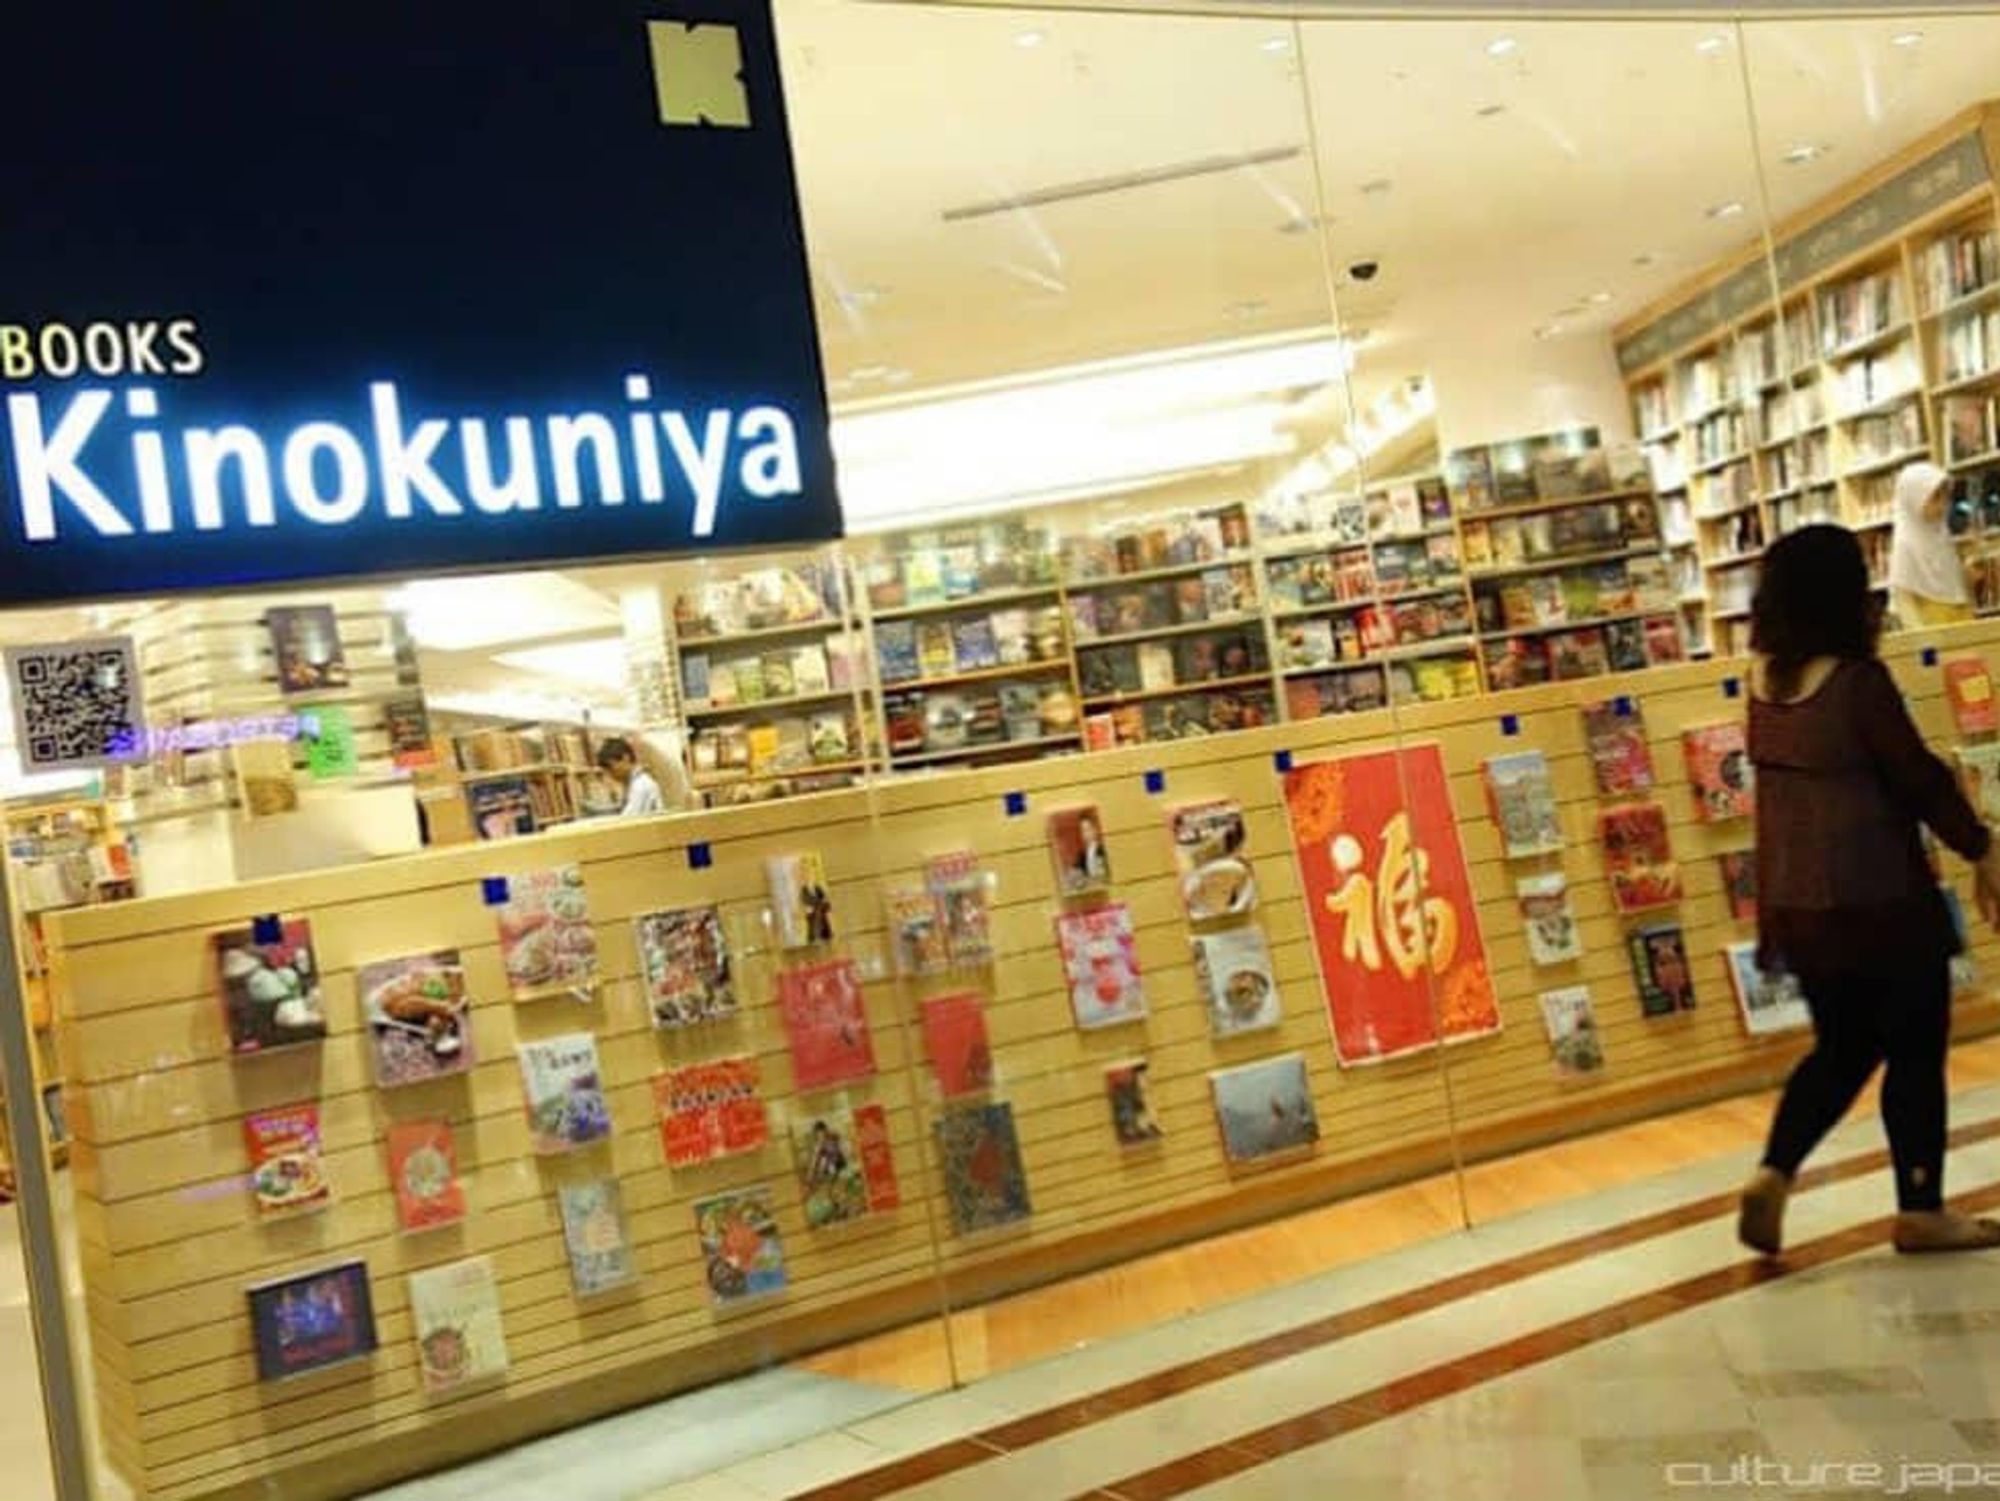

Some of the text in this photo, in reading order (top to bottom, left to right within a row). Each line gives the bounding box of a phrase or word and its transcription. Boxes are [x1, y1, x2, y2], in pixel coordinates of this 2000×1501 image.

[0, 321, 203, 378] BOOKS
[8, 374, 801, 542] Kinokuniya
[1324, 812, 1457, 981] 福
